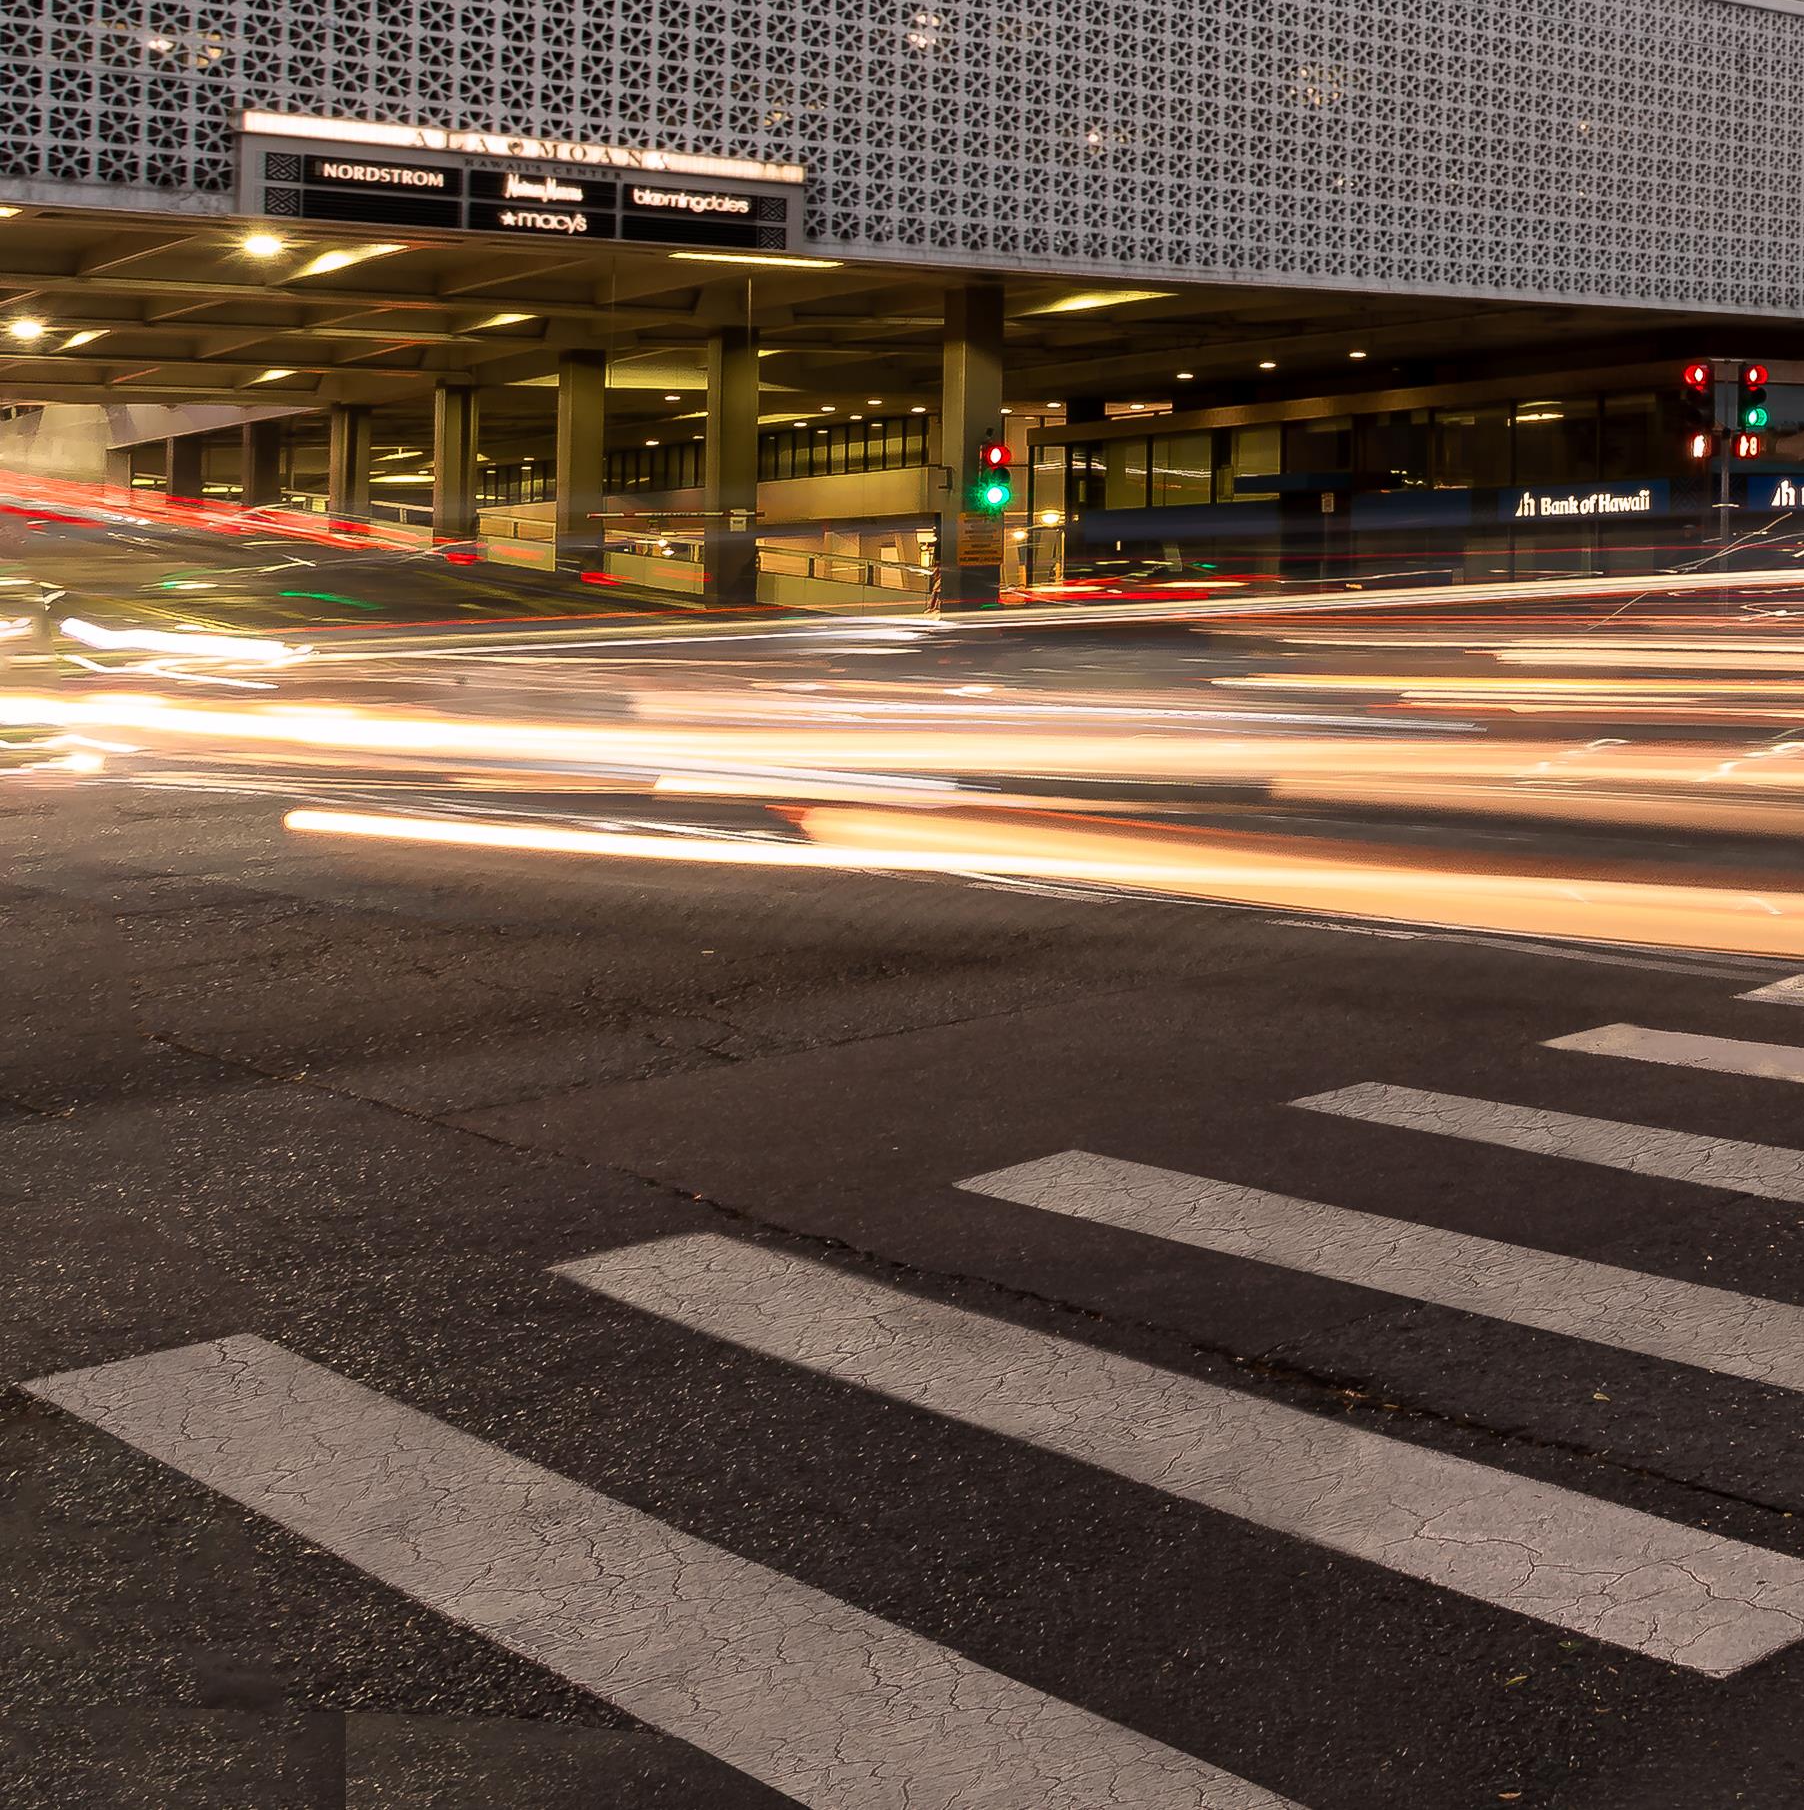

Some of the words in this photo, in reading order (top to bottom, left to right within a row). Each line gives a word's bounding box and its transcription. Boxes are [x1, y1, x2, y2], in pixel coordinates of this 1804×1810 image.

[323, 163, 444, 188] NORDSTROM
[552, 165, 623, 180] CENTER
[1540, 495, 1579, 516] Bank
[1579, 493, 1598, 515] of
[1599, 489, 1650, 513] Hawaii
